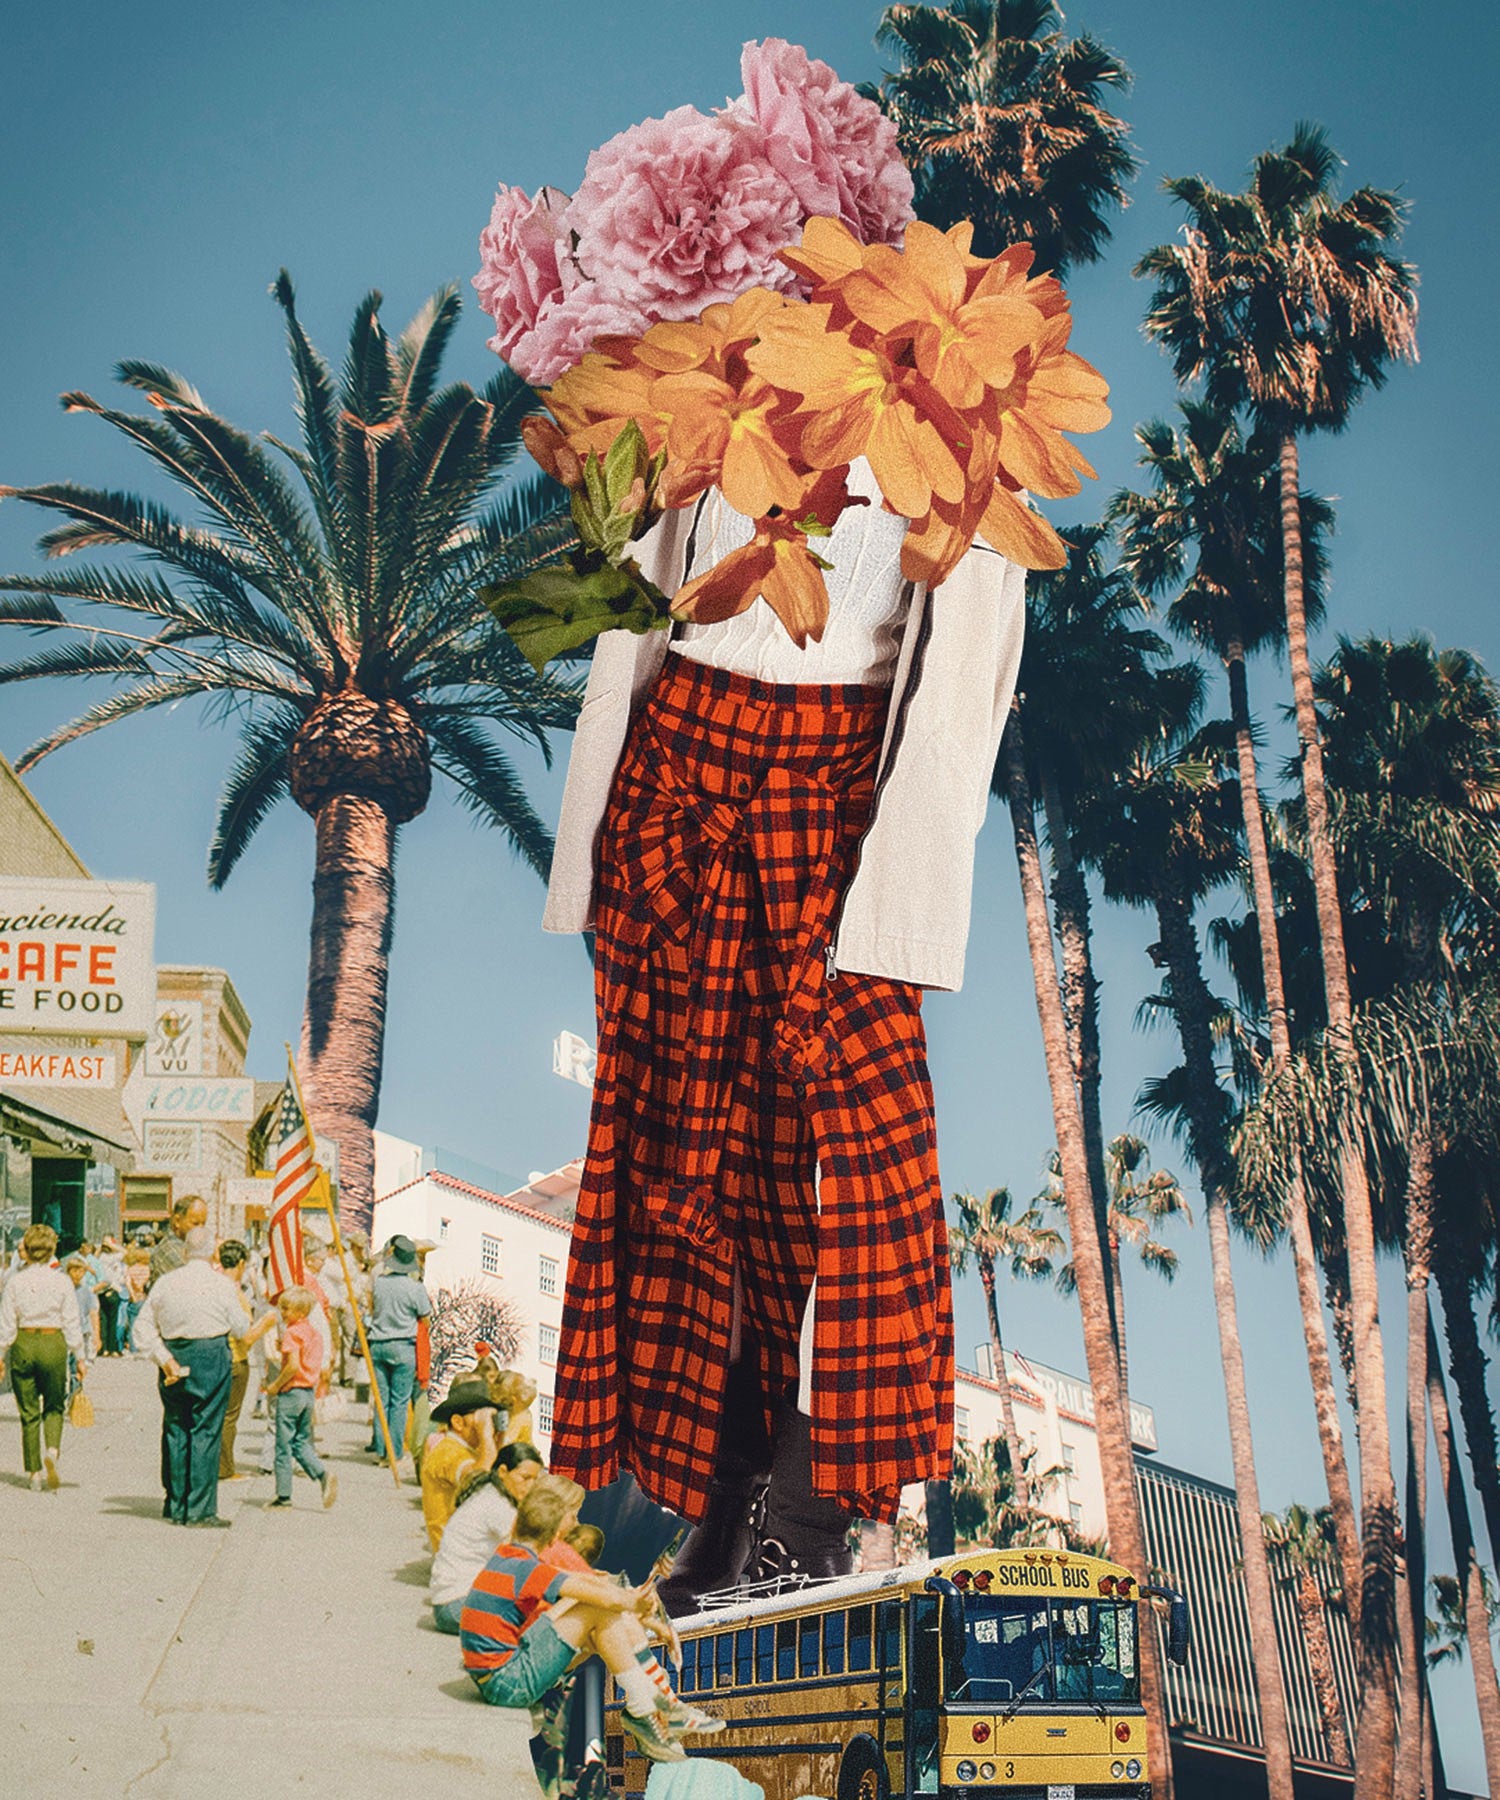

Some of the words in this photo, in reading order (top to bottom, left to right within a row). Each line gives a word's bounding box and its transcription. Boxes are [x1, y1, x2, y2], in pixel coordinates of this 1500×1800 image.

[34, 989, 124, 1013] FOOD
[161, 1059, 188, 1072] VU
[146, 1084, 249, 1113] LODGE
[1034, 1371, 1097, 1421] RAILE
[1129, 1406, 1157, 1444] RK
[999, 1565, 1057, 1587] SCHOOL
[1062, 1567, 1090, 1589] BUS
[1005, 1761, 1015, 1779] 3
